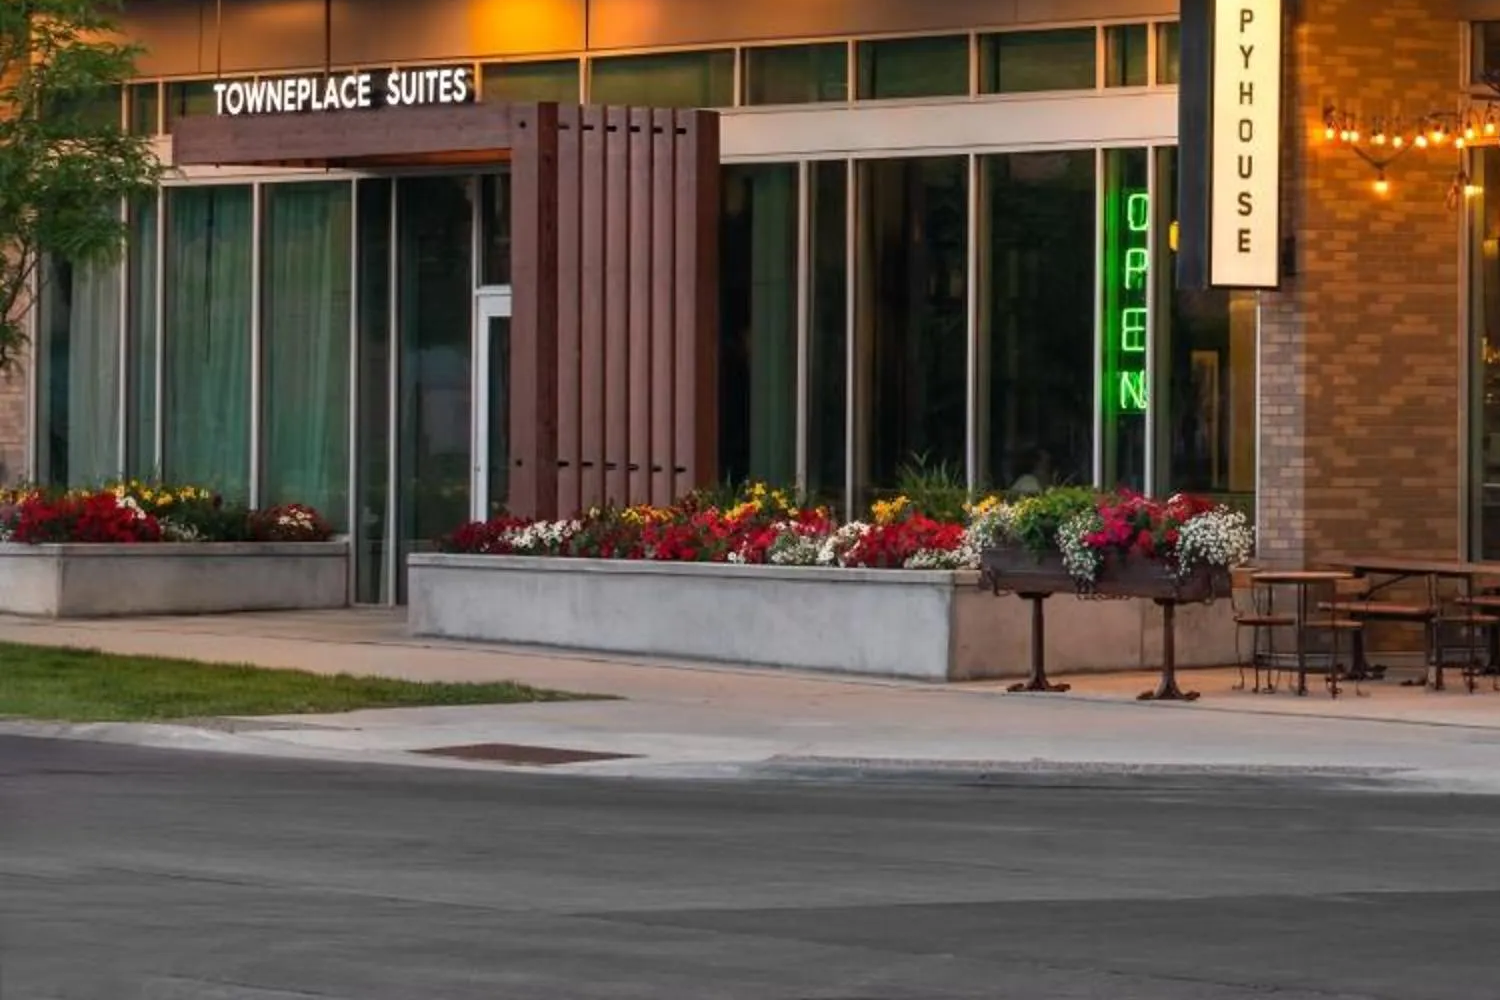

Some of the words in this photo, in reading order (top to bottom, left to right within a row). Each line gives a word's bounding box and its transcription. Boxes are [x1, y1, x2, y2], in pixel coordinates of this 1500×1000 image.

[213, 73, 371, 115] TOWNEPLACE
[386, 67, 467, 106] SUITES
[1120, 193, 1149, 409] OPEN
